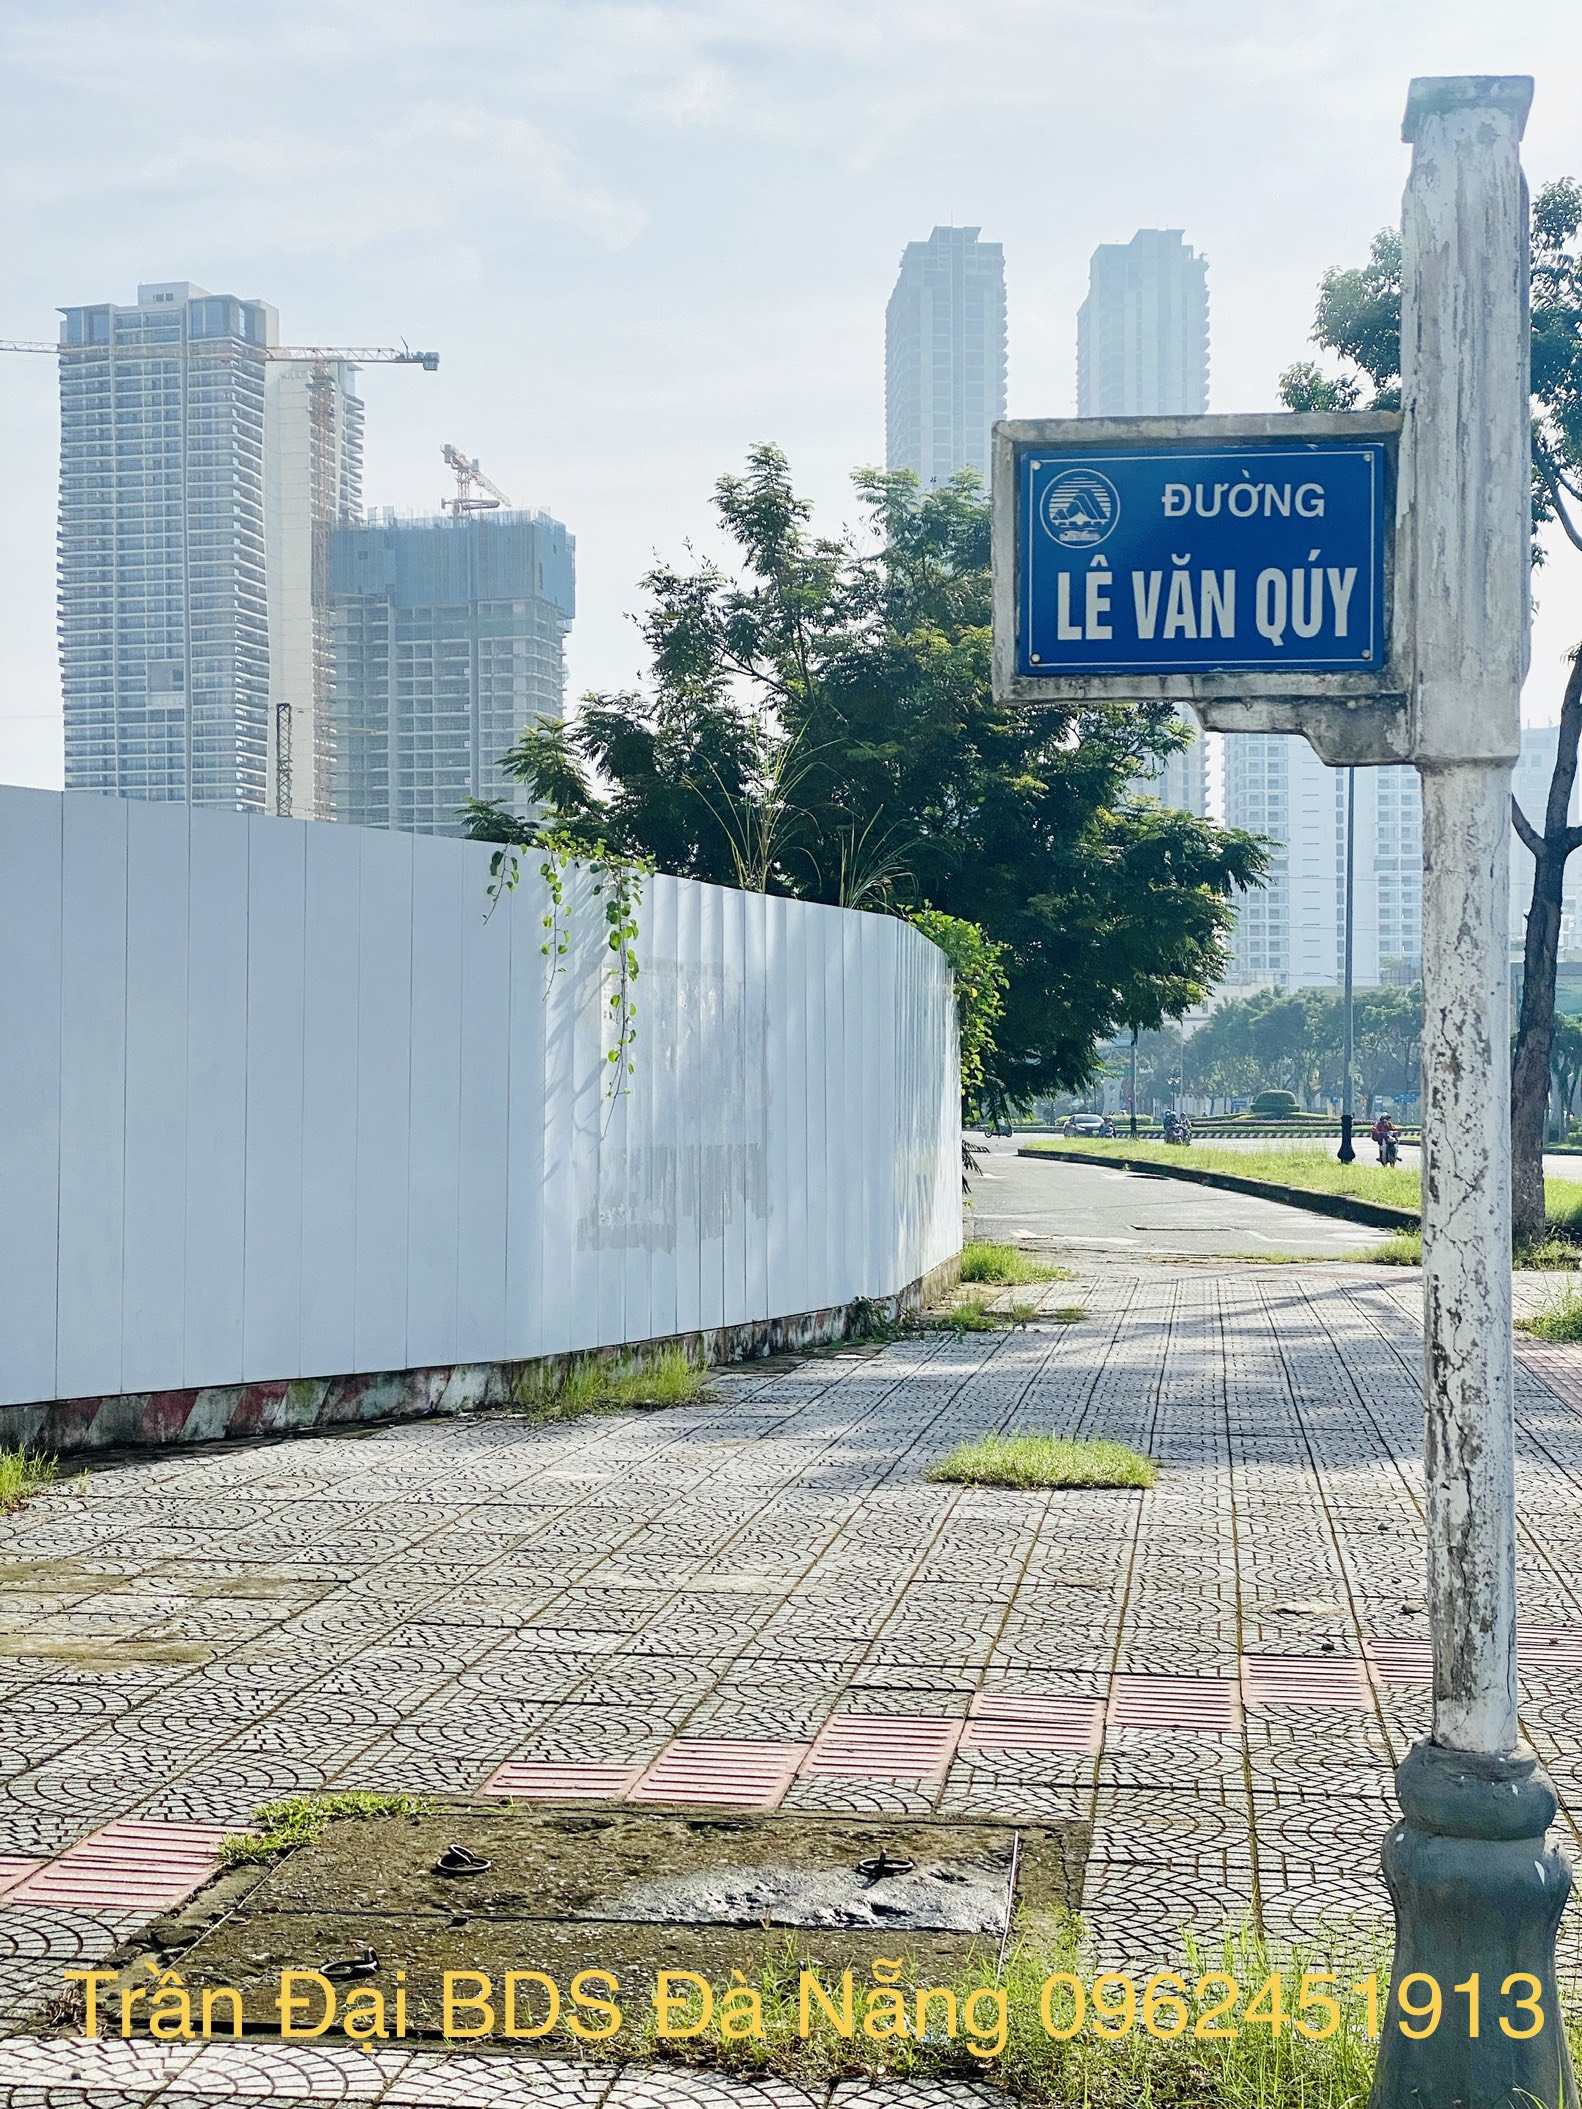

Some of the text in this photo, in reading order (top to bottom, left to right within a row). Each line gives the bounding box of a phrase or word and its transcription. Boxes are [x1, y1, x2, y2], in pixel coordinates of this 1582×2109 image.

[1161, 469, 1325, 518] ĐƯỜNG
[1057, 549, 1358, 647] LÊ VĂN QÚY
